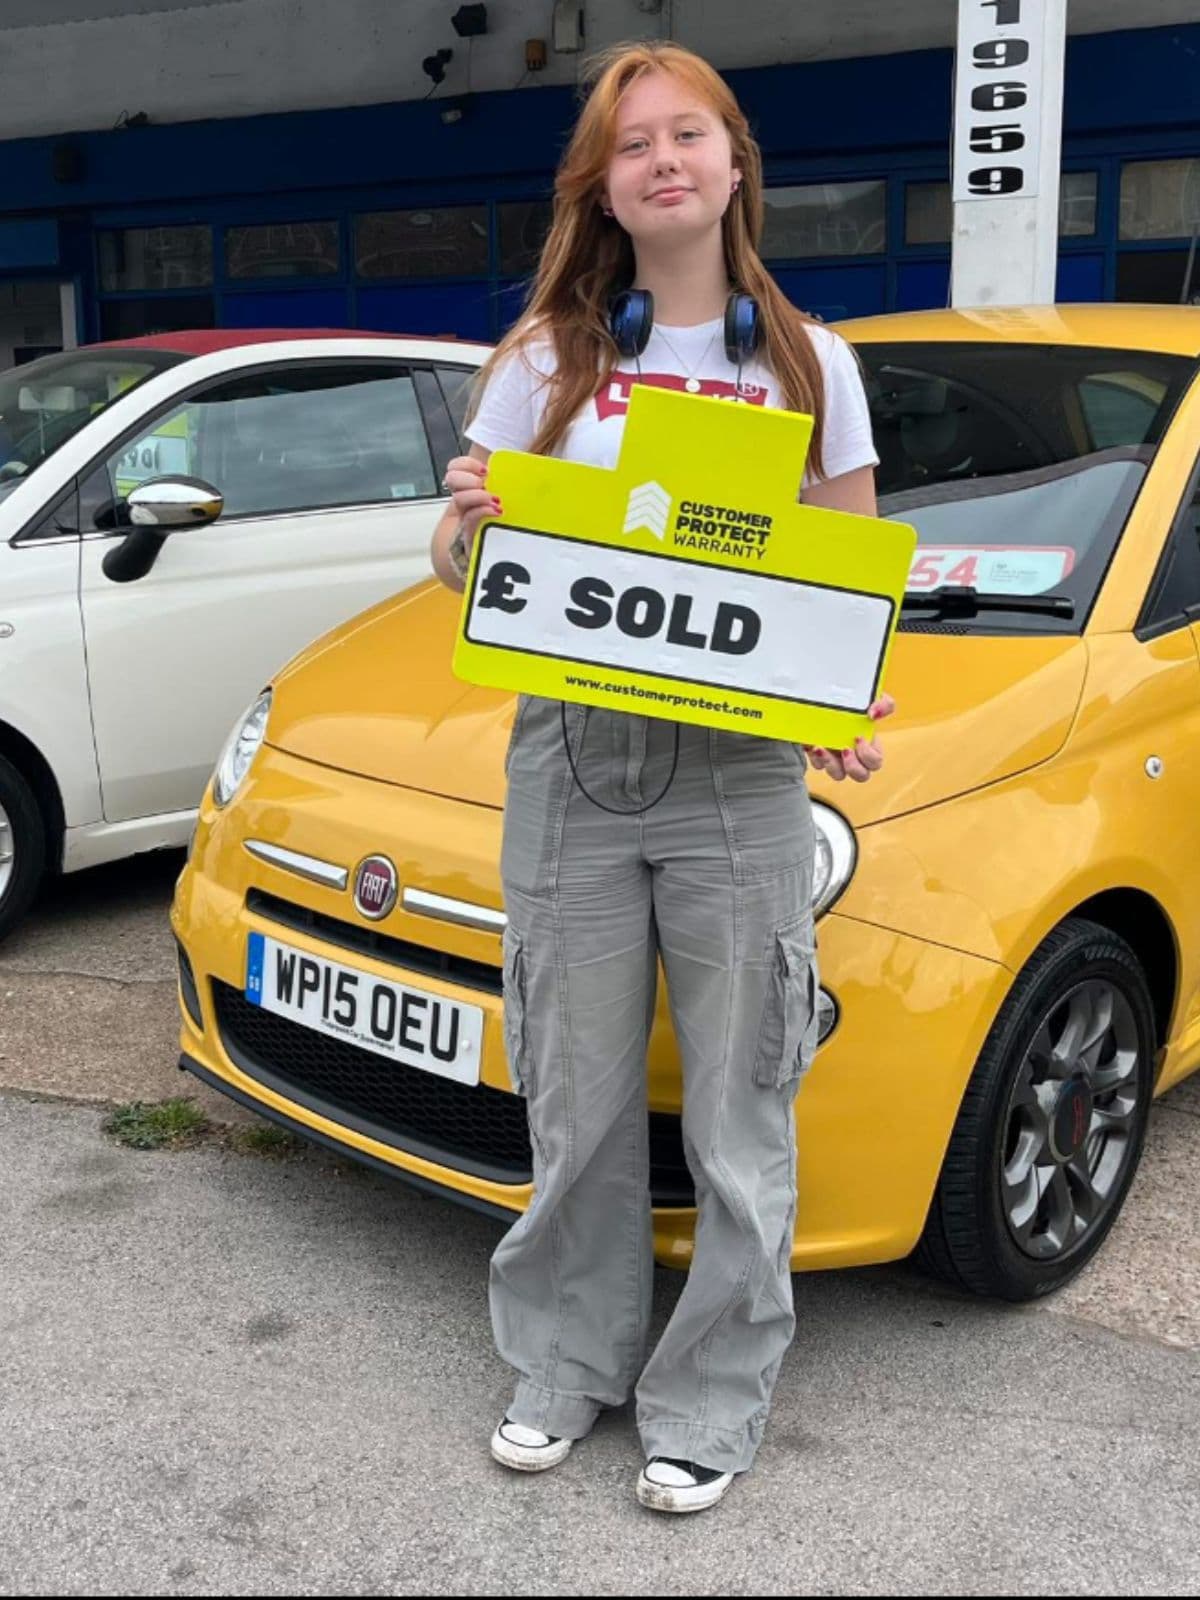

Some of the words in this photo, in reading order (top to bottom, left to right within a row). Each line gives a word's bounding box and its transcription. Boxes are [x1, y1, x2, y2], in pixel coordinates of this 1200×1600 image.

[676, 516, 771, 545] PROTECT
[680, 501, 772, 528] CUSTOMER
[673, 533, 767, 560] WARRANTY
[478, 561, 531, 614] £
[565, 576, 762, 656] SOLD
[565, 675, 763, 719] www.customerprotect.com
[361, 872, 388, 904] FIAT
[277, 948, 359, 1027] WP15
[370, 984, 459, 1062] OEU
